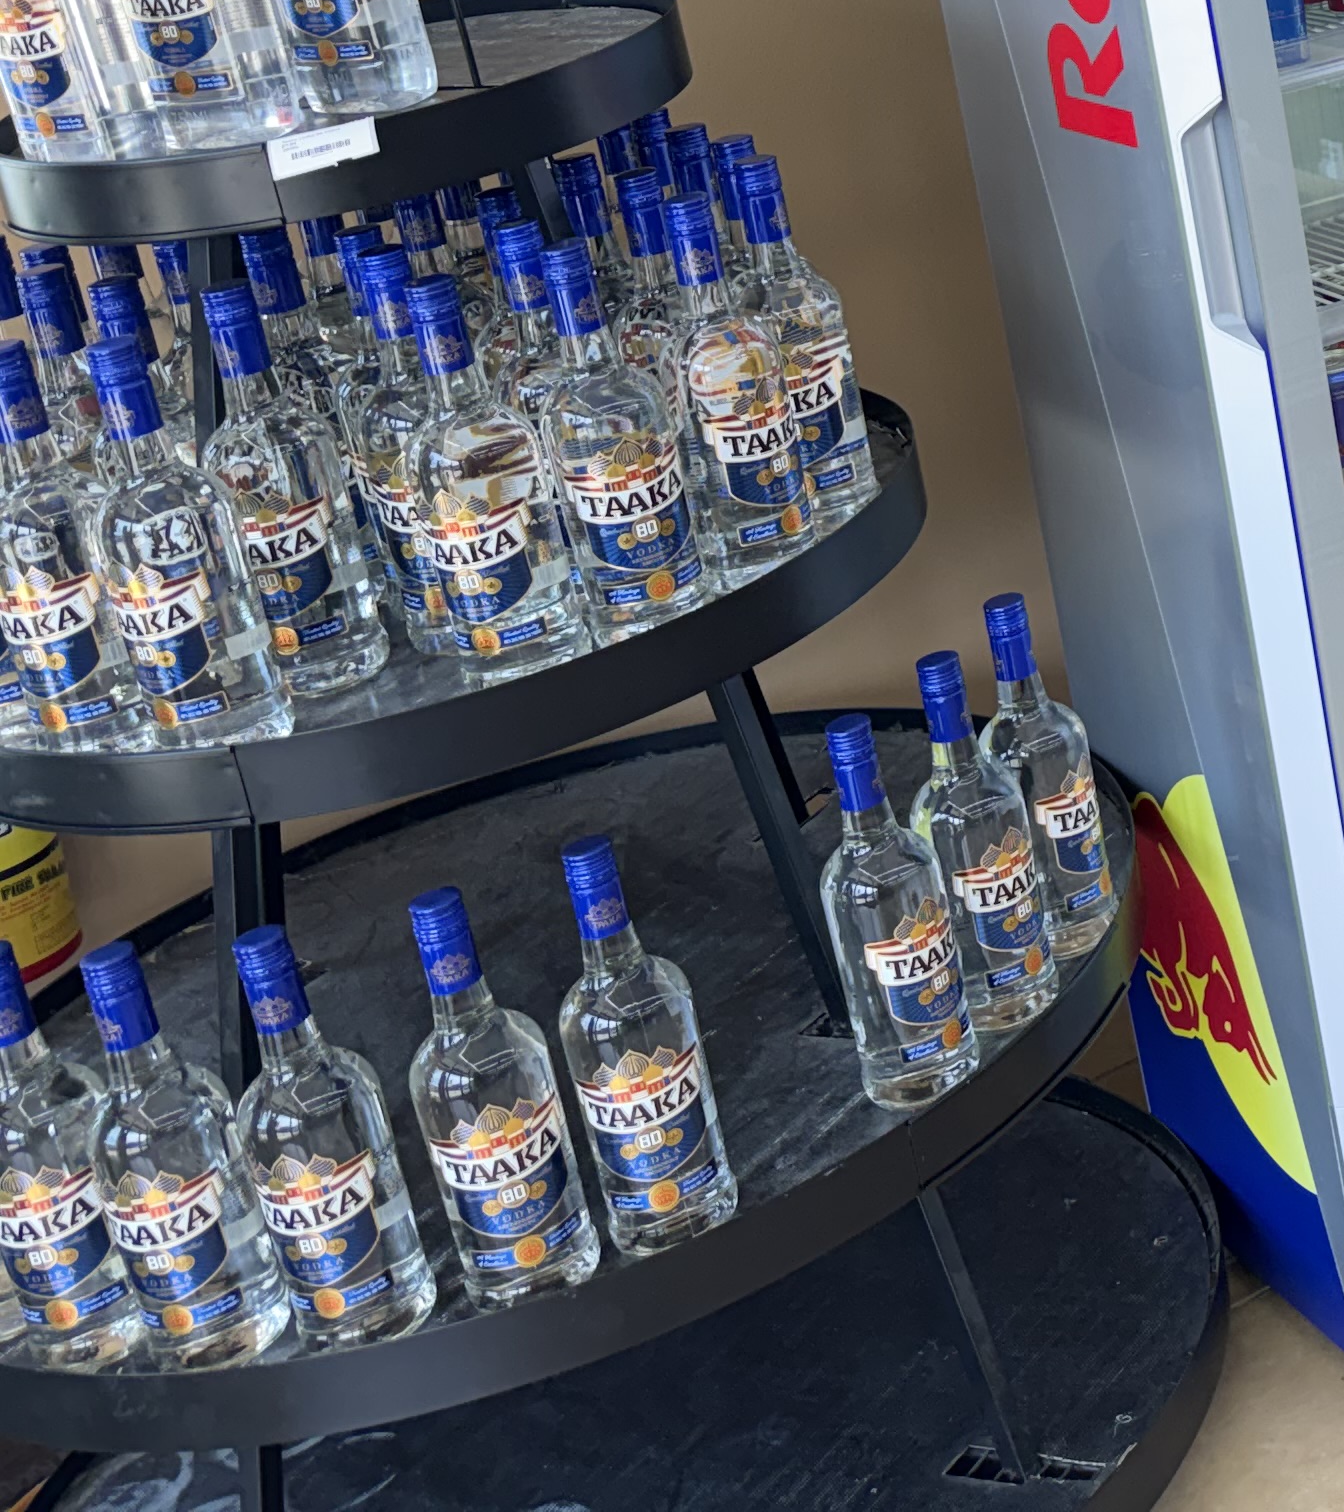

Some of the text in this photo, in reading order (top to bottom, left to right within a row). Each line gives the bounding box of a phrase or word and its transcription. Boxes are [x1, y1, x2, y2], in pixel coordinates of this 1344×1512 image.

[161, 25, 178, 40] 80
[0, 29, 57, 58] AAKA
[19, 64, 35, 78] 80
[773, 457, 790, 473] 80
[581, 470, 684, 519] TAAKA
[380, 499, 418, 525] TAA
[636, 521, 659, 539] 80
[248, 525, 320, 566] AKA
[434, 527, 519, 565] AAKA
[255, 572, 277, 589] 80
[458, 573, 480, 588] 80
[2, 600, 85, 640] AAKA
[117, 600, 194, 639] AAKA
[22, 648, 45, 665] 80
[136, 646, 154, 663] 80
[1053, 797, 1099, 834] TAA
[1017, 899, 1034, 918] 80
[933, 968, 951, 988] 80
[587, 1074, 698, 1129] TAAKA
[639, 1130, 663, 1148] 80
[445, 1128, 558, 1187] TAAKA
[502, 1183, 526, 1203] 80
[2, 1188, 96, 1243] AAKA
[299, 1235, 323, 1253] 80
[28, 1247, 53, 1267] 80
[146, 1253, 168, 1271] 80
